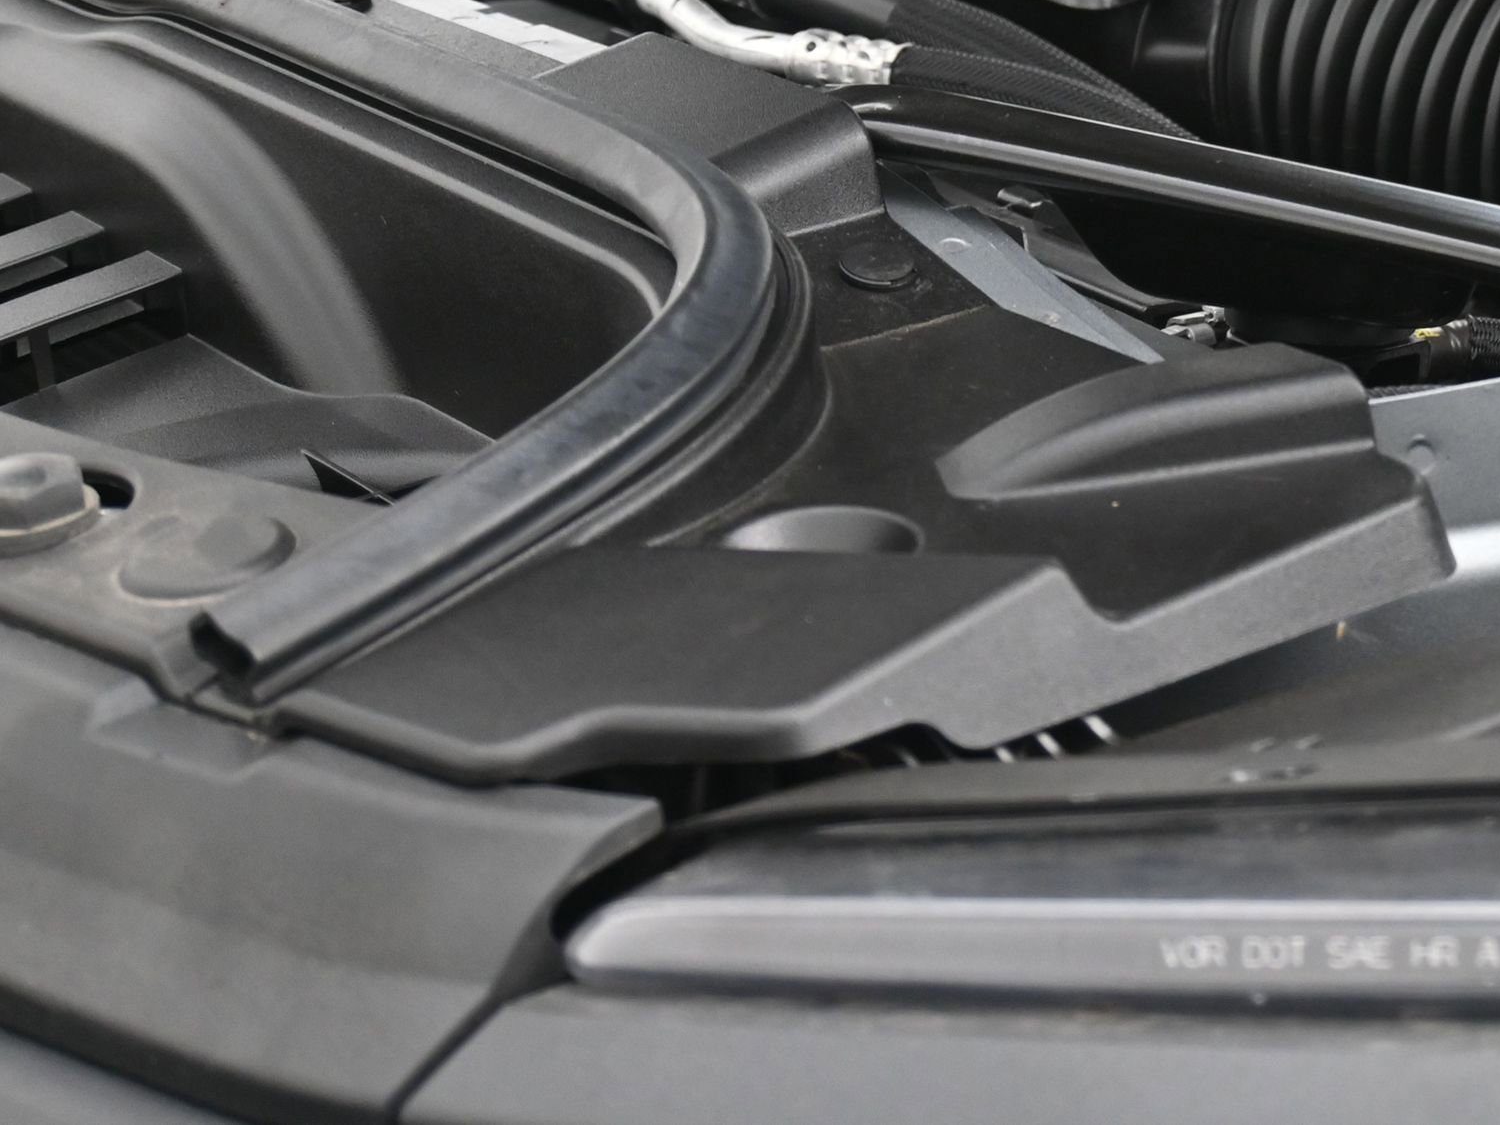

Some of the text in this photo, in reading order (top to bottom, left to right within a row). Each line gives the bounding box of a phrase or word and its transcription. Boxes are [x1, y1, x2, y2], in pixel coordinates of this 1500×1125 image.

[1159, 934, 1228, 969] VOR
[1241, 935, 1305, 970] DOT
[1325, 935, 1393, 970] SAE
[1408, 935, 1459, 968] HR
